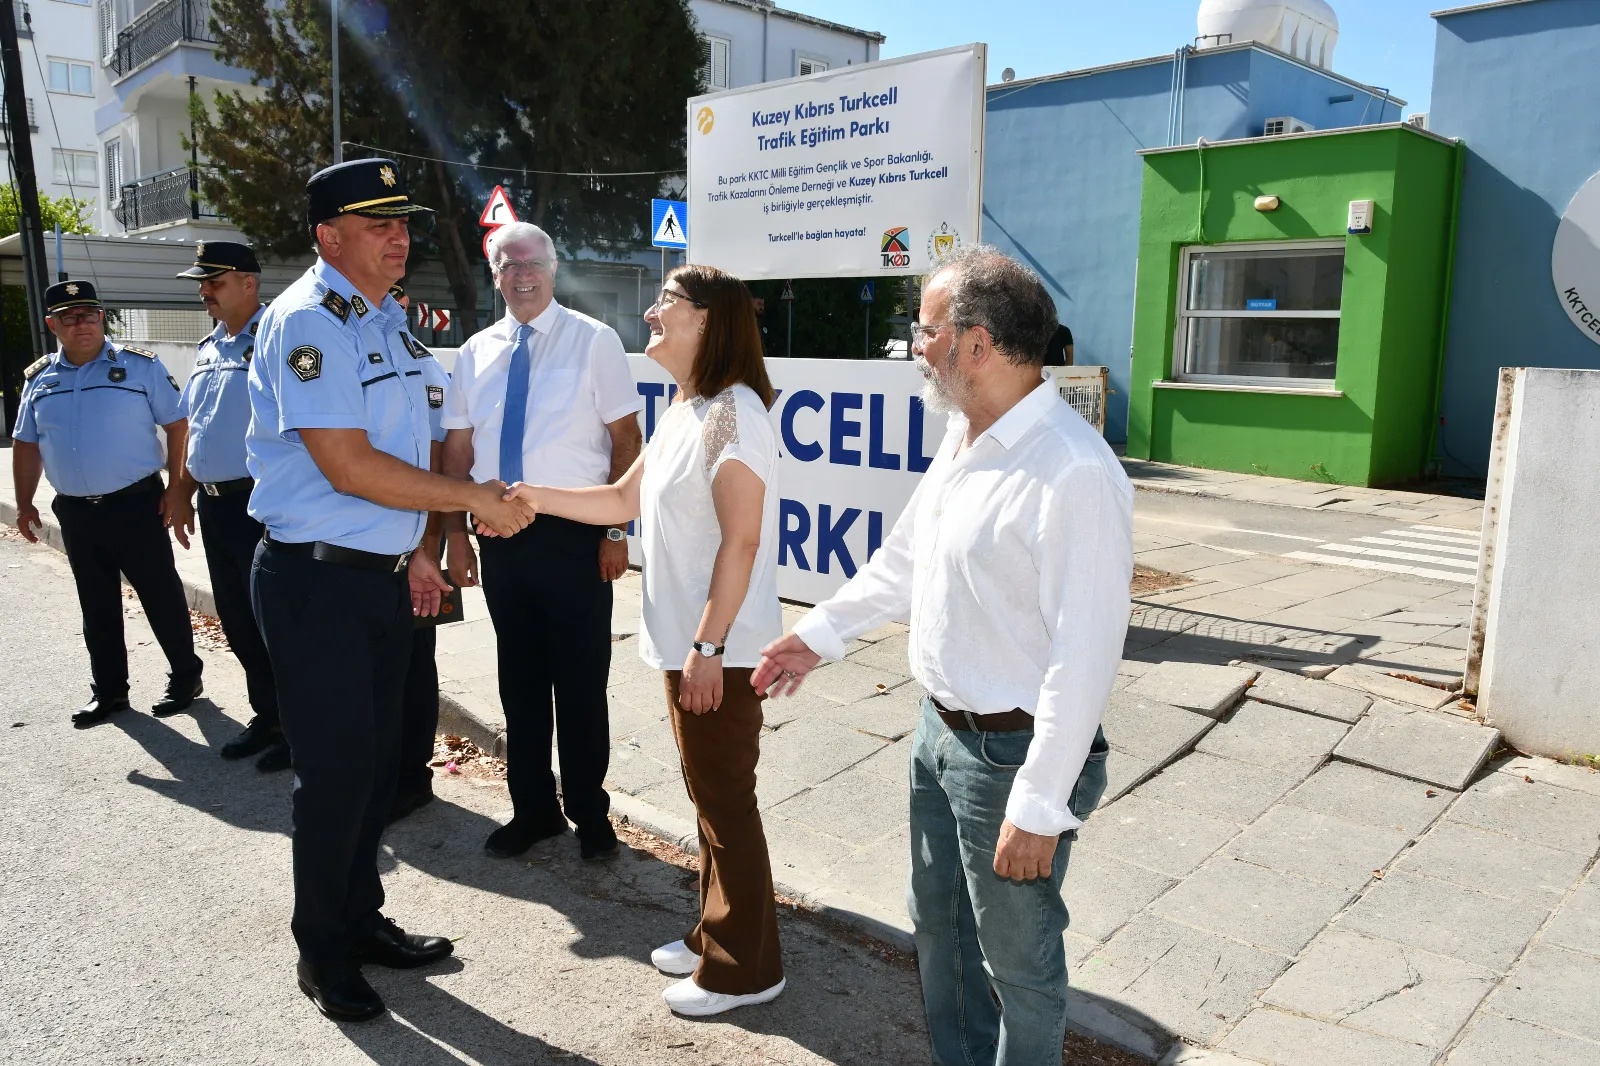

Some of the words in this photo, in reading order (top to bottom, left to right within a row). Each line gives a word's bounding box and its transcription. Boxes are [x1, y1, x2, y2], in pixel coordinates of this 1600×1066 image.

[752, 110, 791, 127] Kuzey
[794, 101, 835, 120] Kıbrıs
[839, 86, 898, 113] Turkcell
[757, 130, 796, 151] Trafik
[800, 125, 845, 148] Eğitim
[850, 116, 890, 138] Parkı
[707, 191, 728, 203] Trafik
[730, 188, 767, 200] Kazalarını
[768, 182, 800, 196] Önleme
[801, 179, 834, 192] Derneği
[836, 179, 847, 188] ve
[849, 176, 877, 188] Kuzey
[878, 172, 907, 184] Kıbrıs
[909, 166, 948, 181] Turkcell
[718, 175, 728, 186] Bu
[729, 173, 747, 186] park
[748, 169, 769, 181] KKTC
[770, 167, 787, 179] Milli
[788, 164, 814, 179] Eğitim
[816, 159, 848, 174] Gençlik
[850, 160, 861, 169] ve
[863, 157, 885, 169] Spor
[763, 203, 770, 216] iş
[771, 199, 805, 213] birliğiyle
[806, 192, 874, 211] gerçekleşmiştir.
[768, 231, 804, 243] Turkcell'le
[805, 229, 833, 242] bağlan
[834, 226, 866, 239] hayata!
[1564, 287, 1600, 337] KKTCE
[636, 382, 935, 474] TCELL
[777, 498, 883, 580] RKI
